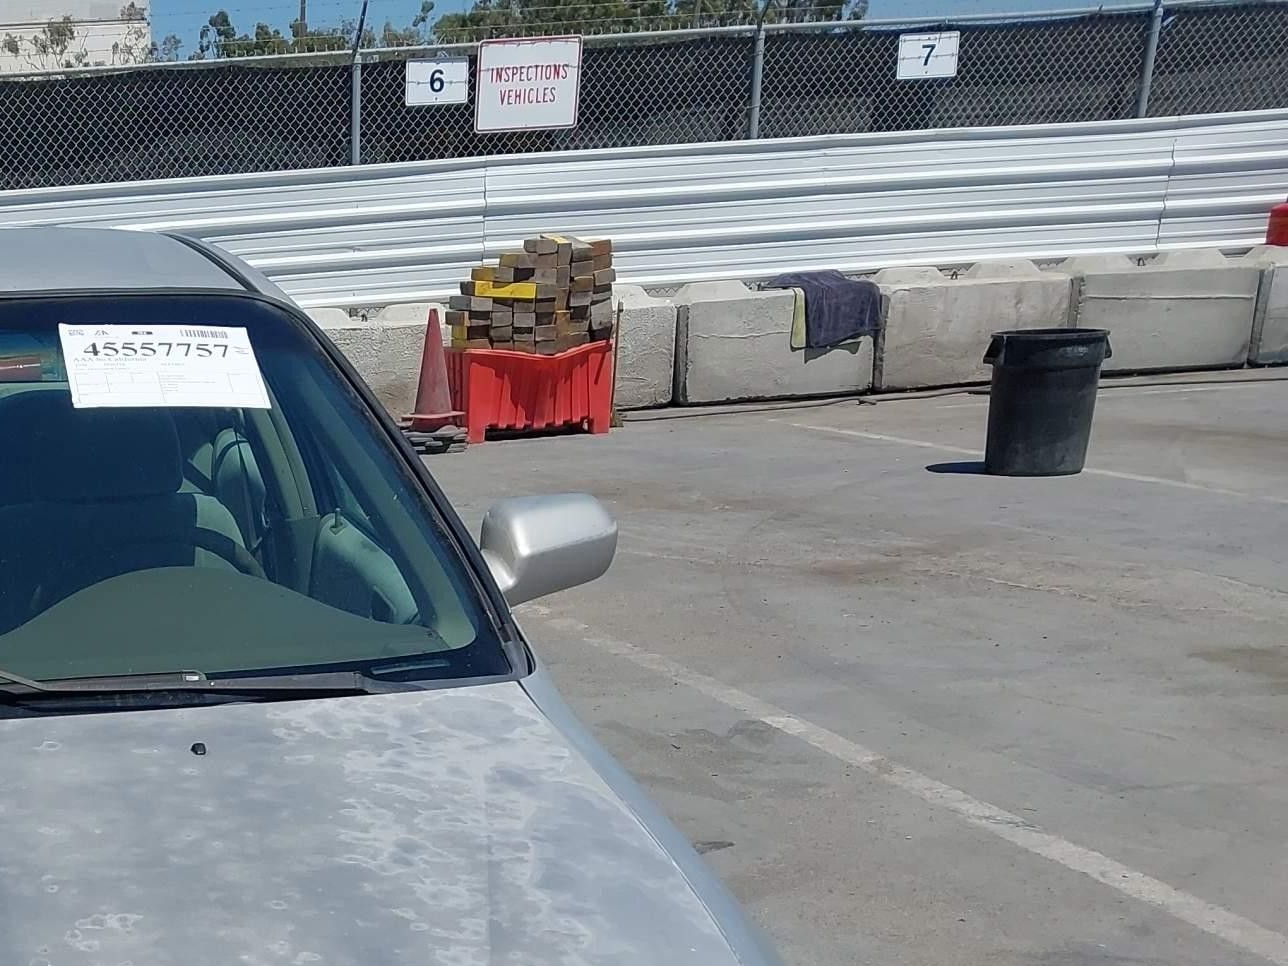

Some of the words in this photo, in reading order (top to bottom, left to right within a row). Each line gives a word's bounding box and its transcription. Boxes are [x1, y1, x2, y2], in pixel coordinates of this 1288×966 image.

[922, 44, 936, 66] 7
[429, 69, 445, 93] 6
[490, 63, 569, 83] INSPECTIONS
[499, 86, 557, 105] VEHICLES
[83, 342, 229, 358] 45557757
